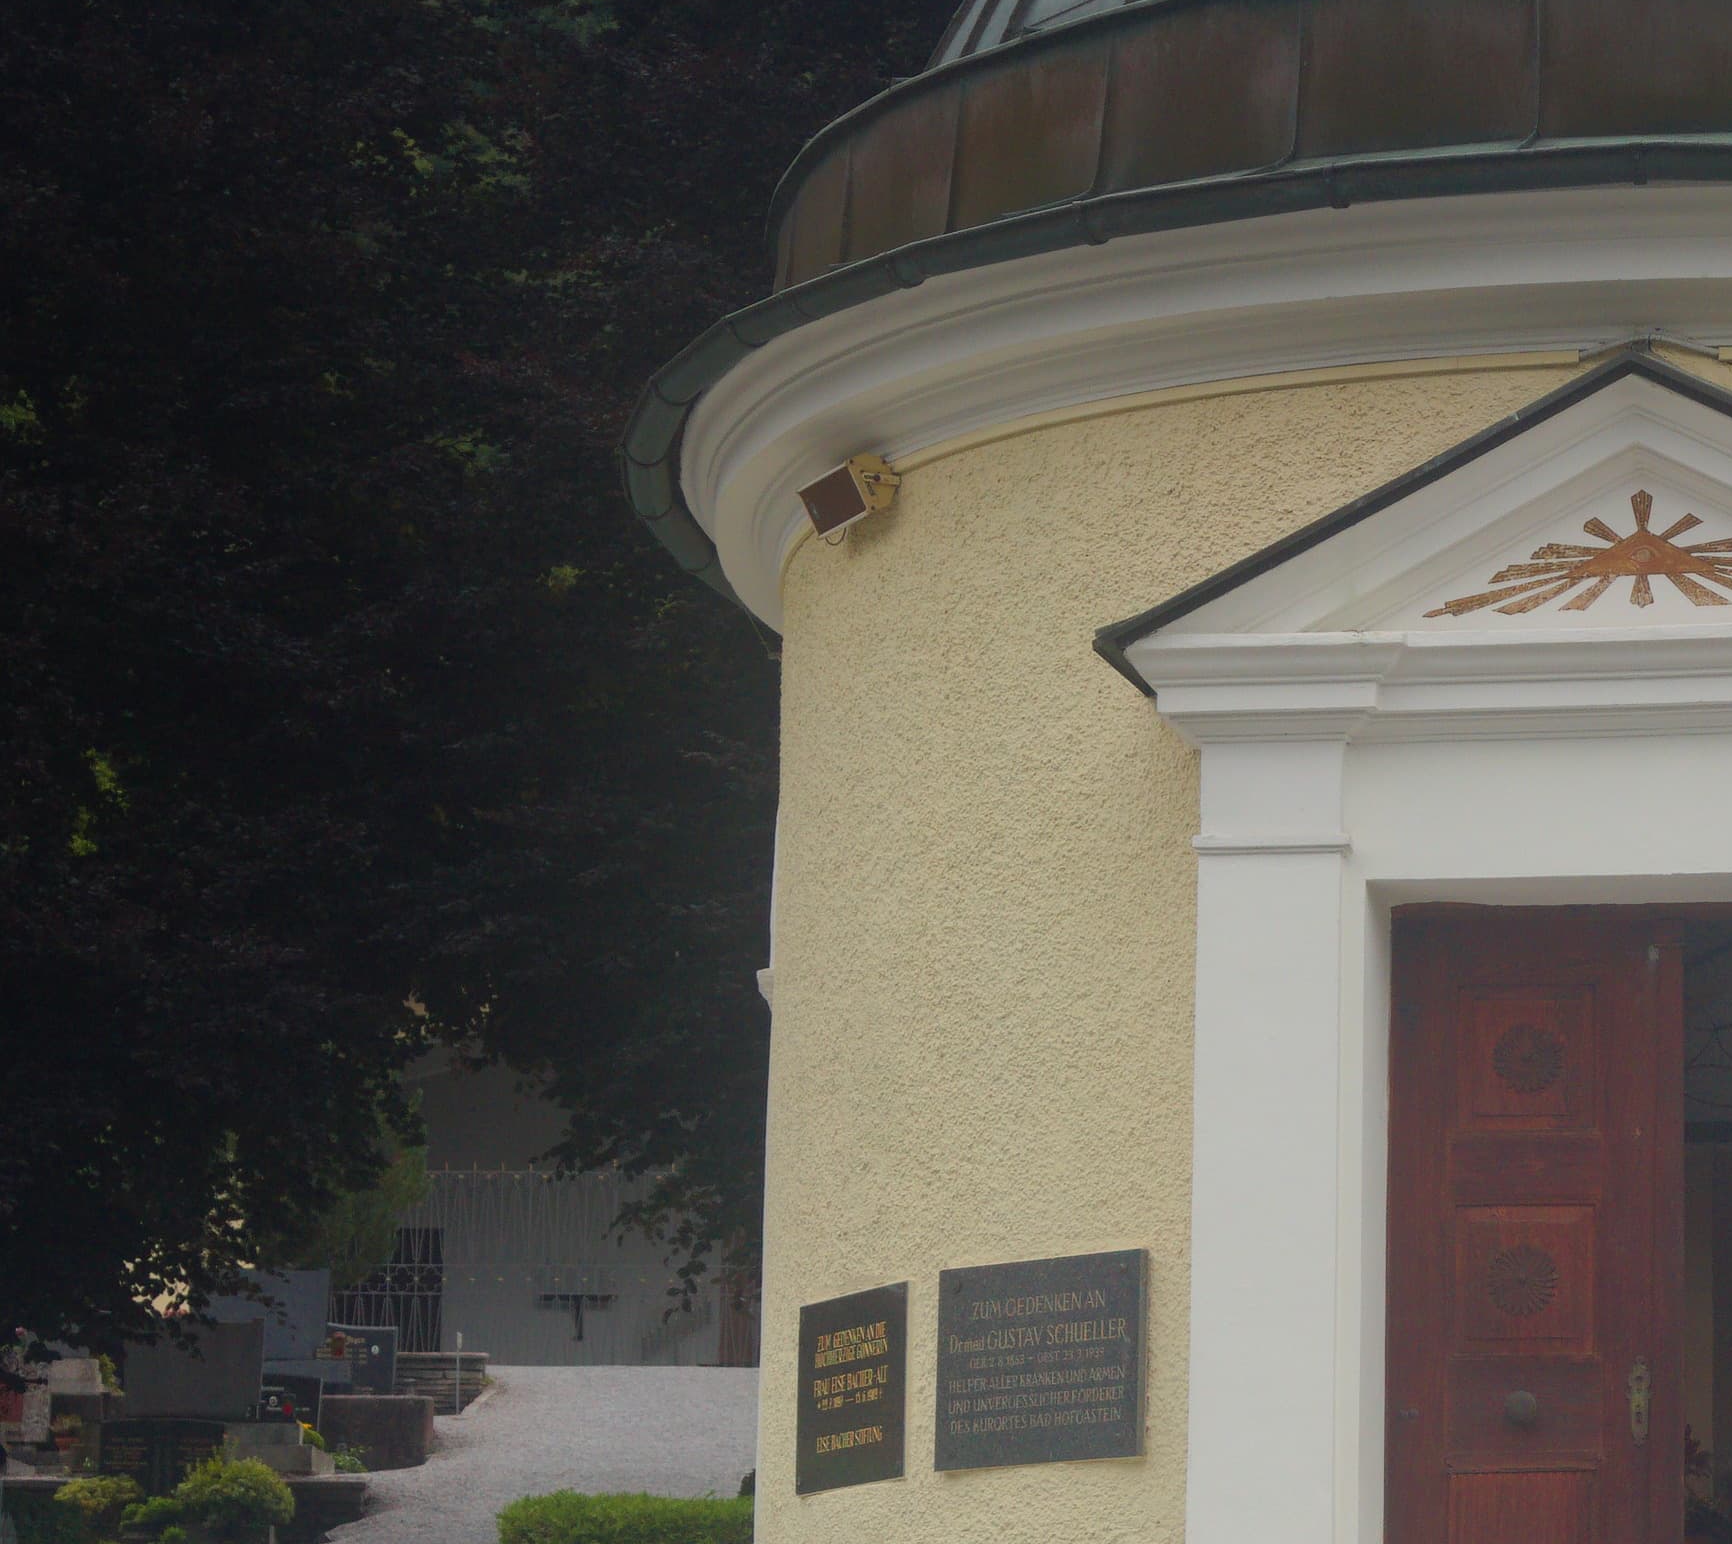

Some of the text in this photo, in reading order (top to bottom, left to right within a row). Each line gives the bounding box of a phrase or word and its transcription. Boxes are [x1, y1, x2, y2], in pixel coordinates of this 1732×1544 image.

[972, 1289, 1106, 1321] ZUM GEDENKEN AN
[987, 1326, 1043, 1350] GUSTAV
[1046, 1318, 1127, 1345] SCHUELLER
[813, 1378, 831, 1398] FRAU
[948, 1377, 987, 1393] HELFER
[1019, 1370, 1066, 1387] KRANKEN
[1066, 1368, 1088, 1383] UND
[1089, 1365, 1126, 1380] ARMEN
[947, 1398, 970, 1415] UND
[949, 1406, 1122, 1434] DES KURORTES BAD HOFGASTEIN
